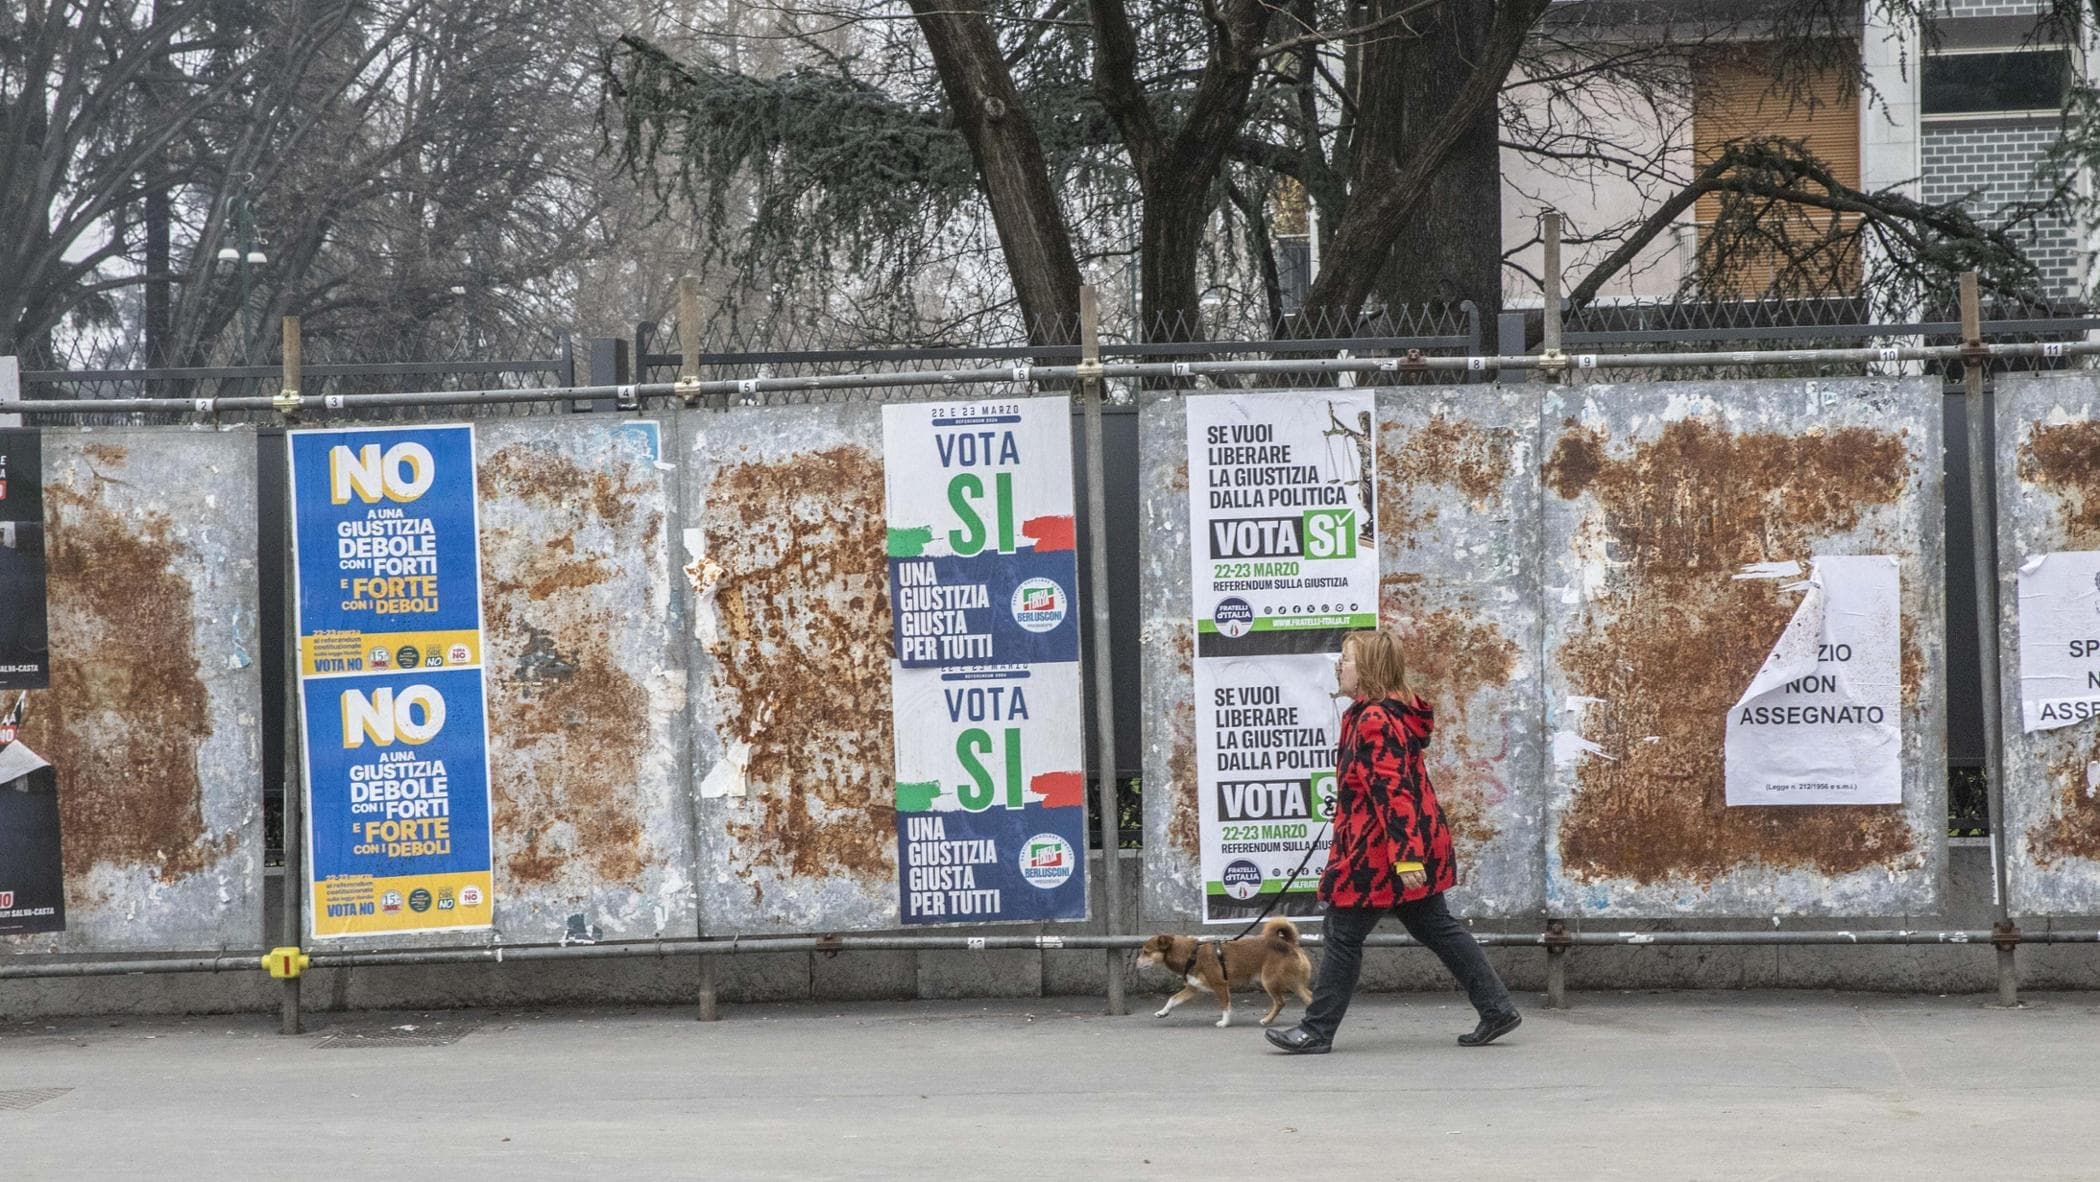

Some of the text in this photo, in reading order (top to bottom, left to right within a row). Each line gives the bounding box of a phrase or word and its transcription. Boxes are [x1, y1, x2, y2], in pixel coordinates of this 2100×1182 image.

[1882, 351, 1895, 360] 10
[2046, 345, 2058, 355] 11
[1178, 365, 1184, 375] 7
[1473, 360, 1480, 369] 8
[1584, 357, 1591, 367] 9
[1018, 370, 1025, 380] 6
[744, 383, 750, 392] 5
[201, 401, 207, 411] 2
[331, 397, 337, 407] 3
[932, 405, 1019, 417] 22 E 23 MARZO
[1207, 424, 1273, 445] SE VUOI
[935, 431, 1020, 468] VOTA
[1208, 445, 1291, 466] LIBERARE
[330, 442, 435, 504] NO
[1209, 465, 1320, 488] LA GIUSTIZIA
[1210, 486, 1348, 509] DALLA POLITICA
[367, 508, 404, 519] A UNA
[947, 472, 1016, 557] SI
[337, 519, 435, 537] GIUSTIZIA
[1214, 520, 1300, 556] VOTA
[338, 536, 437, 558] DEBOLE
[339, 556, 437, 576] CON I FORTI
[899, 561, 937, 587] UNA
[1214, 561, 1300, 579] 22-23 MARZO
[341, 576, 438, 599] E FORTE
[1213, 577, 1349, 591] REFERENDUM SULLA GIUSTIZIA
[341, 598, 438, 614] CON I DEBOLI
[900, 584, 990, 612] GIUSTIZIA
[1220, 604, 1249, 612] FRATELLI
[901, 610, 967, 636] GIUSTA
[1017, 611, 1062, 622] BERLUSCONI
[902, 634, 993, 661] PER TUTTI
[1818, 644, 1852, 662] ZIO
[315, 658, 344, 672] VOTA
[347, 657, 362, 671] NO
[427, 657, 441, 666] NO
[1786, 675, 1836, 694] NON
[944, 686, 1029, 723] VOTA
[1215, 686, 1280, 706] SE VUOI
[341, 684, 446, 748] NO
[1216, 707, 1298, 728] LIBERARE
[1740, 706, 1884, 725] ASSEGNATO
[1216, 728, 1327, 750] LA GIUSTIZIA
[380, 751, 416, 762] A UNA
[1217, 748, 1337, 772] DALLA POLITIC
[350, 761, 446, 781] GIUSTIZIA
[955, 727, 1023, 811] SI
[351, 777, 448, 802] DEBOLE
[1221, 776, 1337, 818] VOTA S
[351, 799, 449, 819] CON I FORTI
[353, 818, 449, 843] E FORTE
[907, 817, 945, 842] UNA
[1222, 823, 1307, 840] 22-23 MARZO
[353, 840, 450, 858] CON I DEBOLI
[908, 840, 998, 867] GIUSTIZIA
[1221, 842, 1280, 854] REFERENDUM
[1282, 841, 1311, 852] SULLA
[909, 866, 975, 891] GIUSTA
[1024, 867, 1070, 878] BERLUSCONI
[327, 903, 356, 917] VOTA
[359, 902, 374, 915] NO
[439, 900, 453, 909] NO
[910, 890, 1001, 916] PER TUTTI
